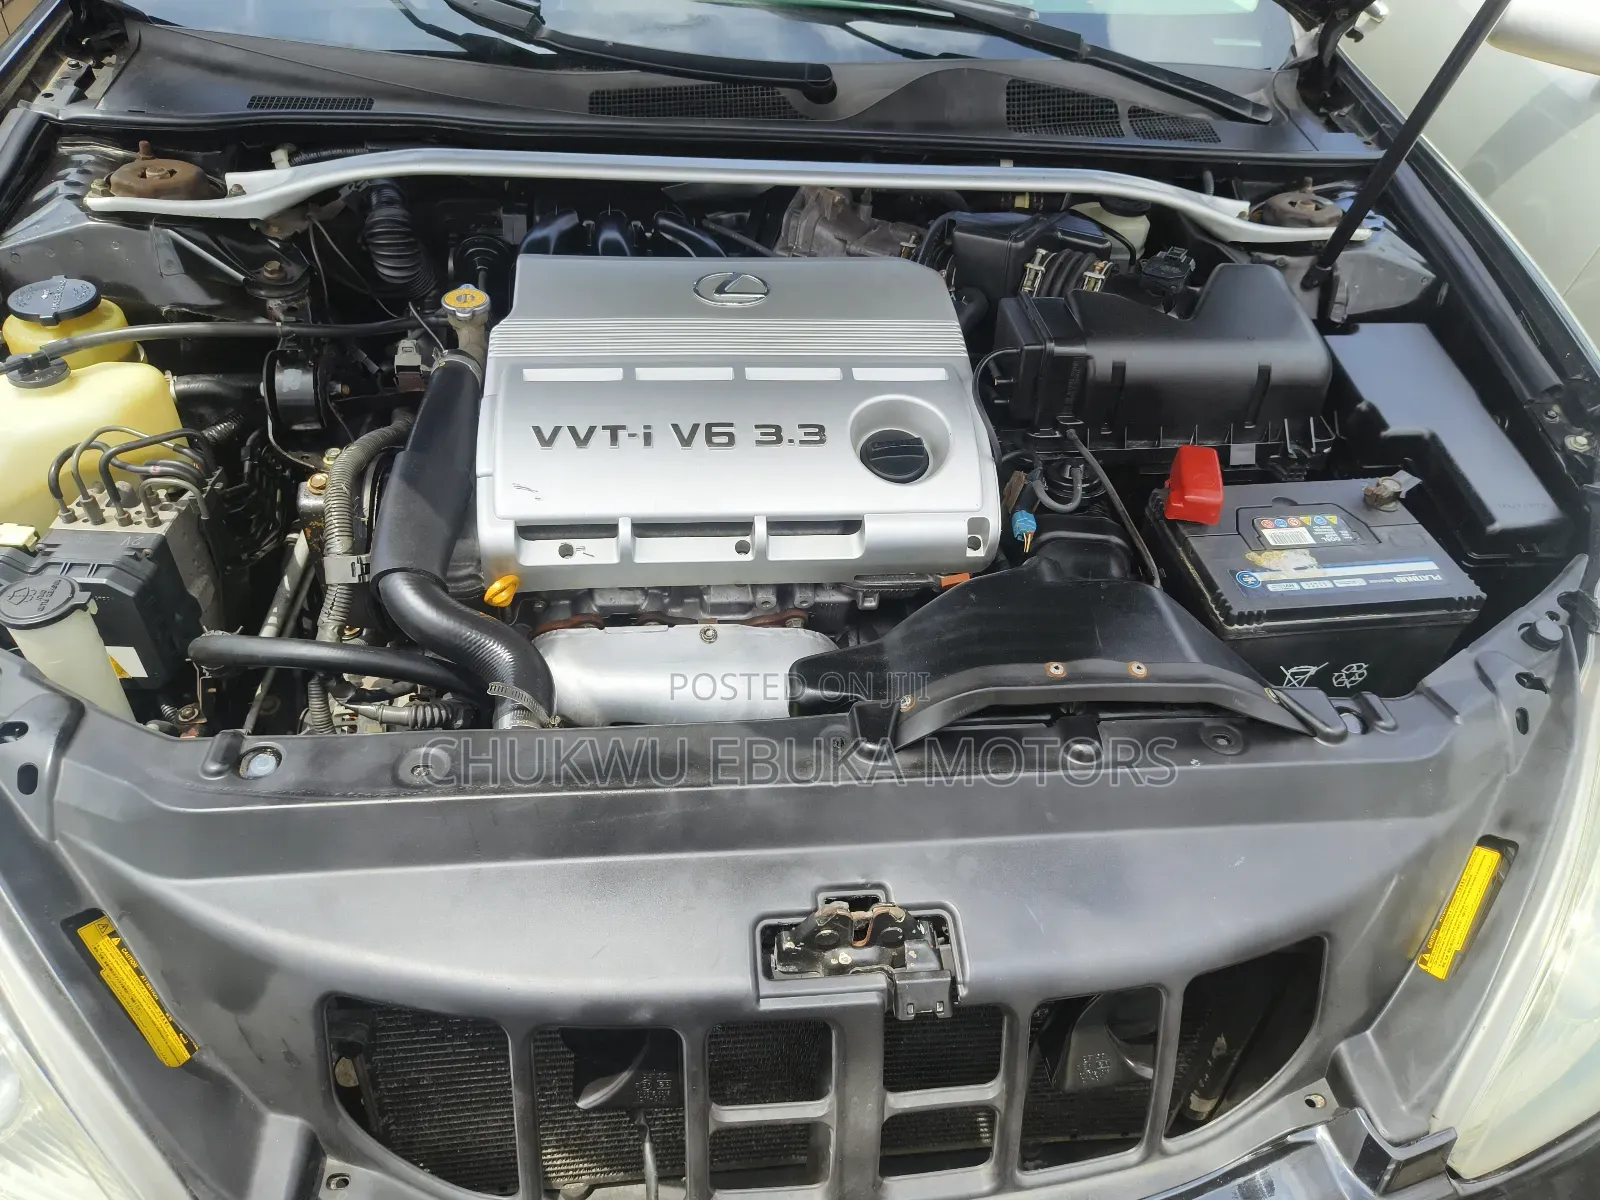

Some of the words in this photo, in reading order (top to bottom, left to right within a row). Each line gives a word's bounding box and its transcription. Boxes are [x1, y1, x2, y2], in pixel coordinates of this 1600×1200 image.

[531, 424, 653, 448] VVT-i
[671, 422, 737, 449] V6
[754, 423, 828, 447] 3.3
[1394, 574, 1442, 583] PLATINUM
[121, 947, 139, 969] CAUTION
